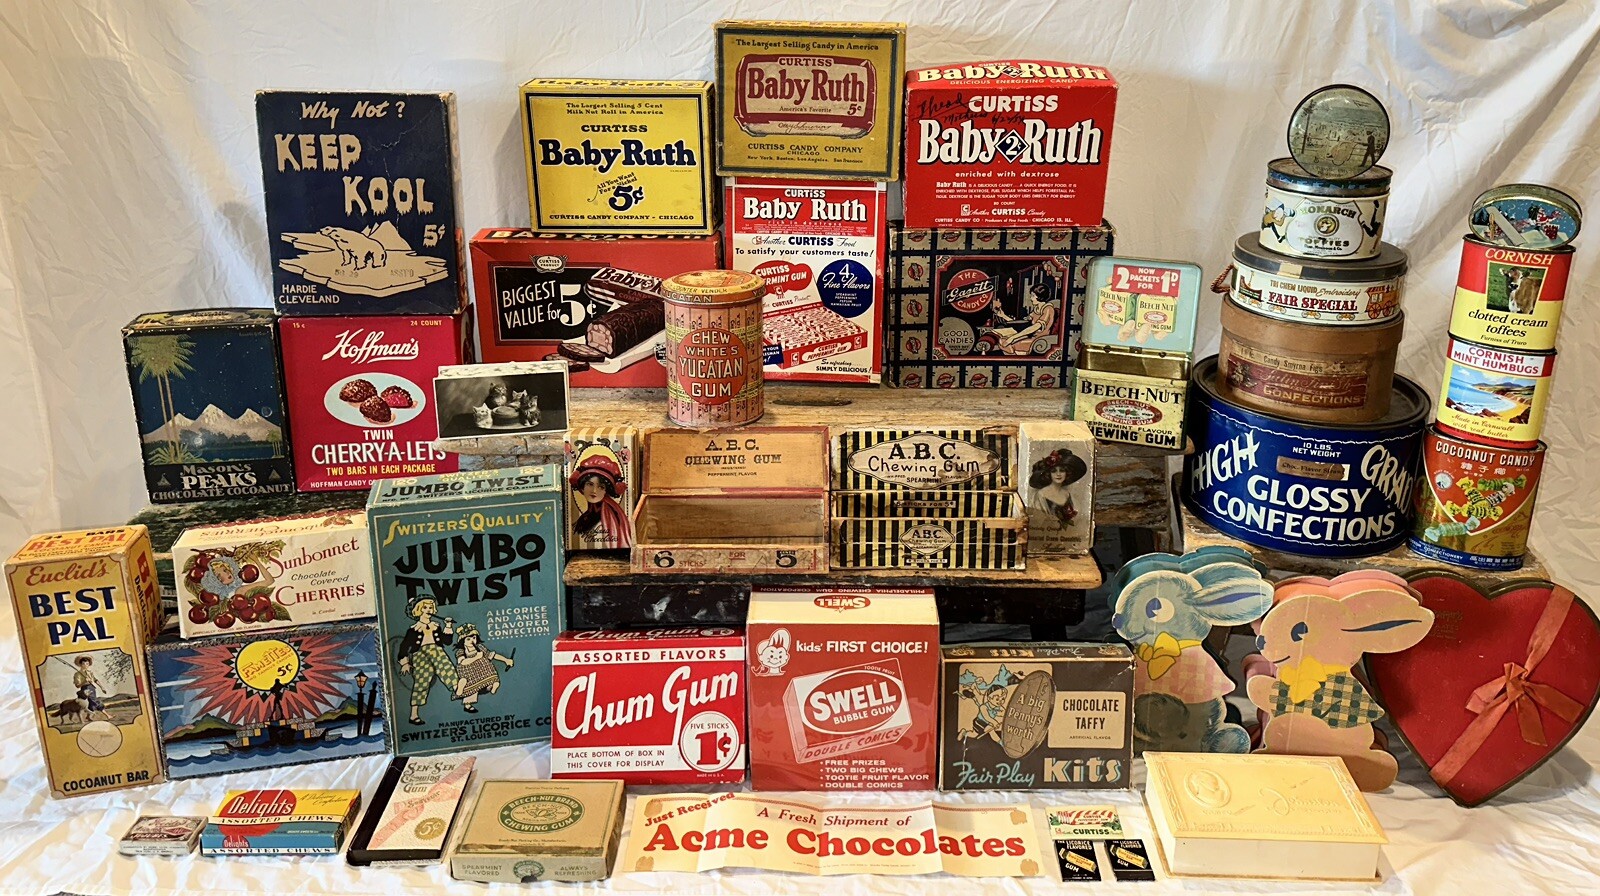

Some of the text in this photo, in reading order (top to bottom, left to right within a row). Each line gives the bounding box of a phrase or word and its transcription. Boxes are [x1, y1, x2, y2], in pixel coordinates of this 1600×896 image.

[752, 40, 780, 50] Largest
[783, 41, 810, 51] Selling
[812, 42, 835, 50] Candy
[778, 57, 833, 66] CURTISS
[748, 68, 865, 105] Baby Ruth
[581, 125, 647, 133] CURTISS
[275, 134, 361, 172] KEEP
[539, 140, 696, 173] Baby Ruth
[343, 176, 433, 216] KOOL
[743, 198, 867, 221] Baby Ruth
[1485, 247, 1555, 265] CORNISH
[959, 272, 978, 280] THE
[1130, 275, 1160, 283] PACKETS
[282, 285, 317, 293] HARDIE
[502, 280, 556, 307] BIGGEST
[279, 295, 340, 304] CLEVELAND
[504, 284, 597, 329] VALUE for 5¢
[1140, 301, 1174, 312] BEECH NUT
[1268, 292, 1358, 311] FAIR SPECIAL
[1468, 309, 1548, 327] clotted cream
[692, 332, 730, 344] CHEW
[1486, 323, 1527, 337] toffees
[322, 328, 419, 364] Hoffman's
[685, 346, 738, 356] WHITE'S
[1454, 351, 1539, 374] MINT HUMBUGS
[1468, 347, 1524, 364] CORNISH
[679, 357, 742, 379] YUCATAN
[691, 382, 731, 397] GUM
[1081, 380, 1182, 404] BEECH-NUT
[1452, 414, 1470, 424] Made
[1480, 421, 1514, 432] Cornwall
[1453, 421, 1508, 438] with real butter
[363, 430, 394, 440] TWIN
[1145, 433, 1175, 446] GUM
[684, 454, 781, 466] CHEWING GUM
[1292, 446, 1340, 457] NET WEIGHT
[1436, 440, 1535, 466] COCOANUT CANDY
[327, 464, 436, 476] TWO BARS IN EACH PACKAGE
[1191, 430, 1261, 494] HIGH
[181, 473, 257, 489] PEAKS
[310, 480, 342, 488] HOFFMAN
[382, 475, 544, 497] JUMBO TWIST
[152, 484, 292, 500] CHOCOLATE COCOANUT
[1247, 475, 1371, 513] GLOSSY
[1213, 491, 1396, 540] CONFECTIONS
[266, 537, 359, 578] Sunbonnet
[393, 533, 546, 575] JUMBO
[25, 559, 110, 587] Euclid's
[291, 570, 336, 582] Chocolate
[310, 575, 349, 586] Covered
[395, 560, 541, 606] TWIST
[28, 586, 116, 618] BEST
[275, 583, 365, 606] CHERRIES
[487, 619, 549, 630] FLAVORED
[515, 613, 548, 621] ANISE
[47, 617, 115, 645] PAL
[488, 626, 550, 637] CONFECTION
[573, 650, 726, 662] ASSORTED FLAVORS
[556, 665, 738, 746] Chum Gum
[810, 681, 896, 721] SWELL
[1063, 699, 1119, 711] CHOCOLATE
[438, 716, 501, 728] MANUFACTURED
[833, 705, 895, 725] BUBBLE GUM
[1076, 717, 1105, 730] TAFFY
[63, 770, 150, 792] COCOANUT BAR
[508, 794, 579, 810] BEECH-NUT BRAND
[644, 792, 735, 827] Just Received
[504, 817, 574, 832] CHEWING GUM
[757, 807, 912, 828] A Fresh Shipment of
[643, 823, 1026, 857] Acme Chocolates
